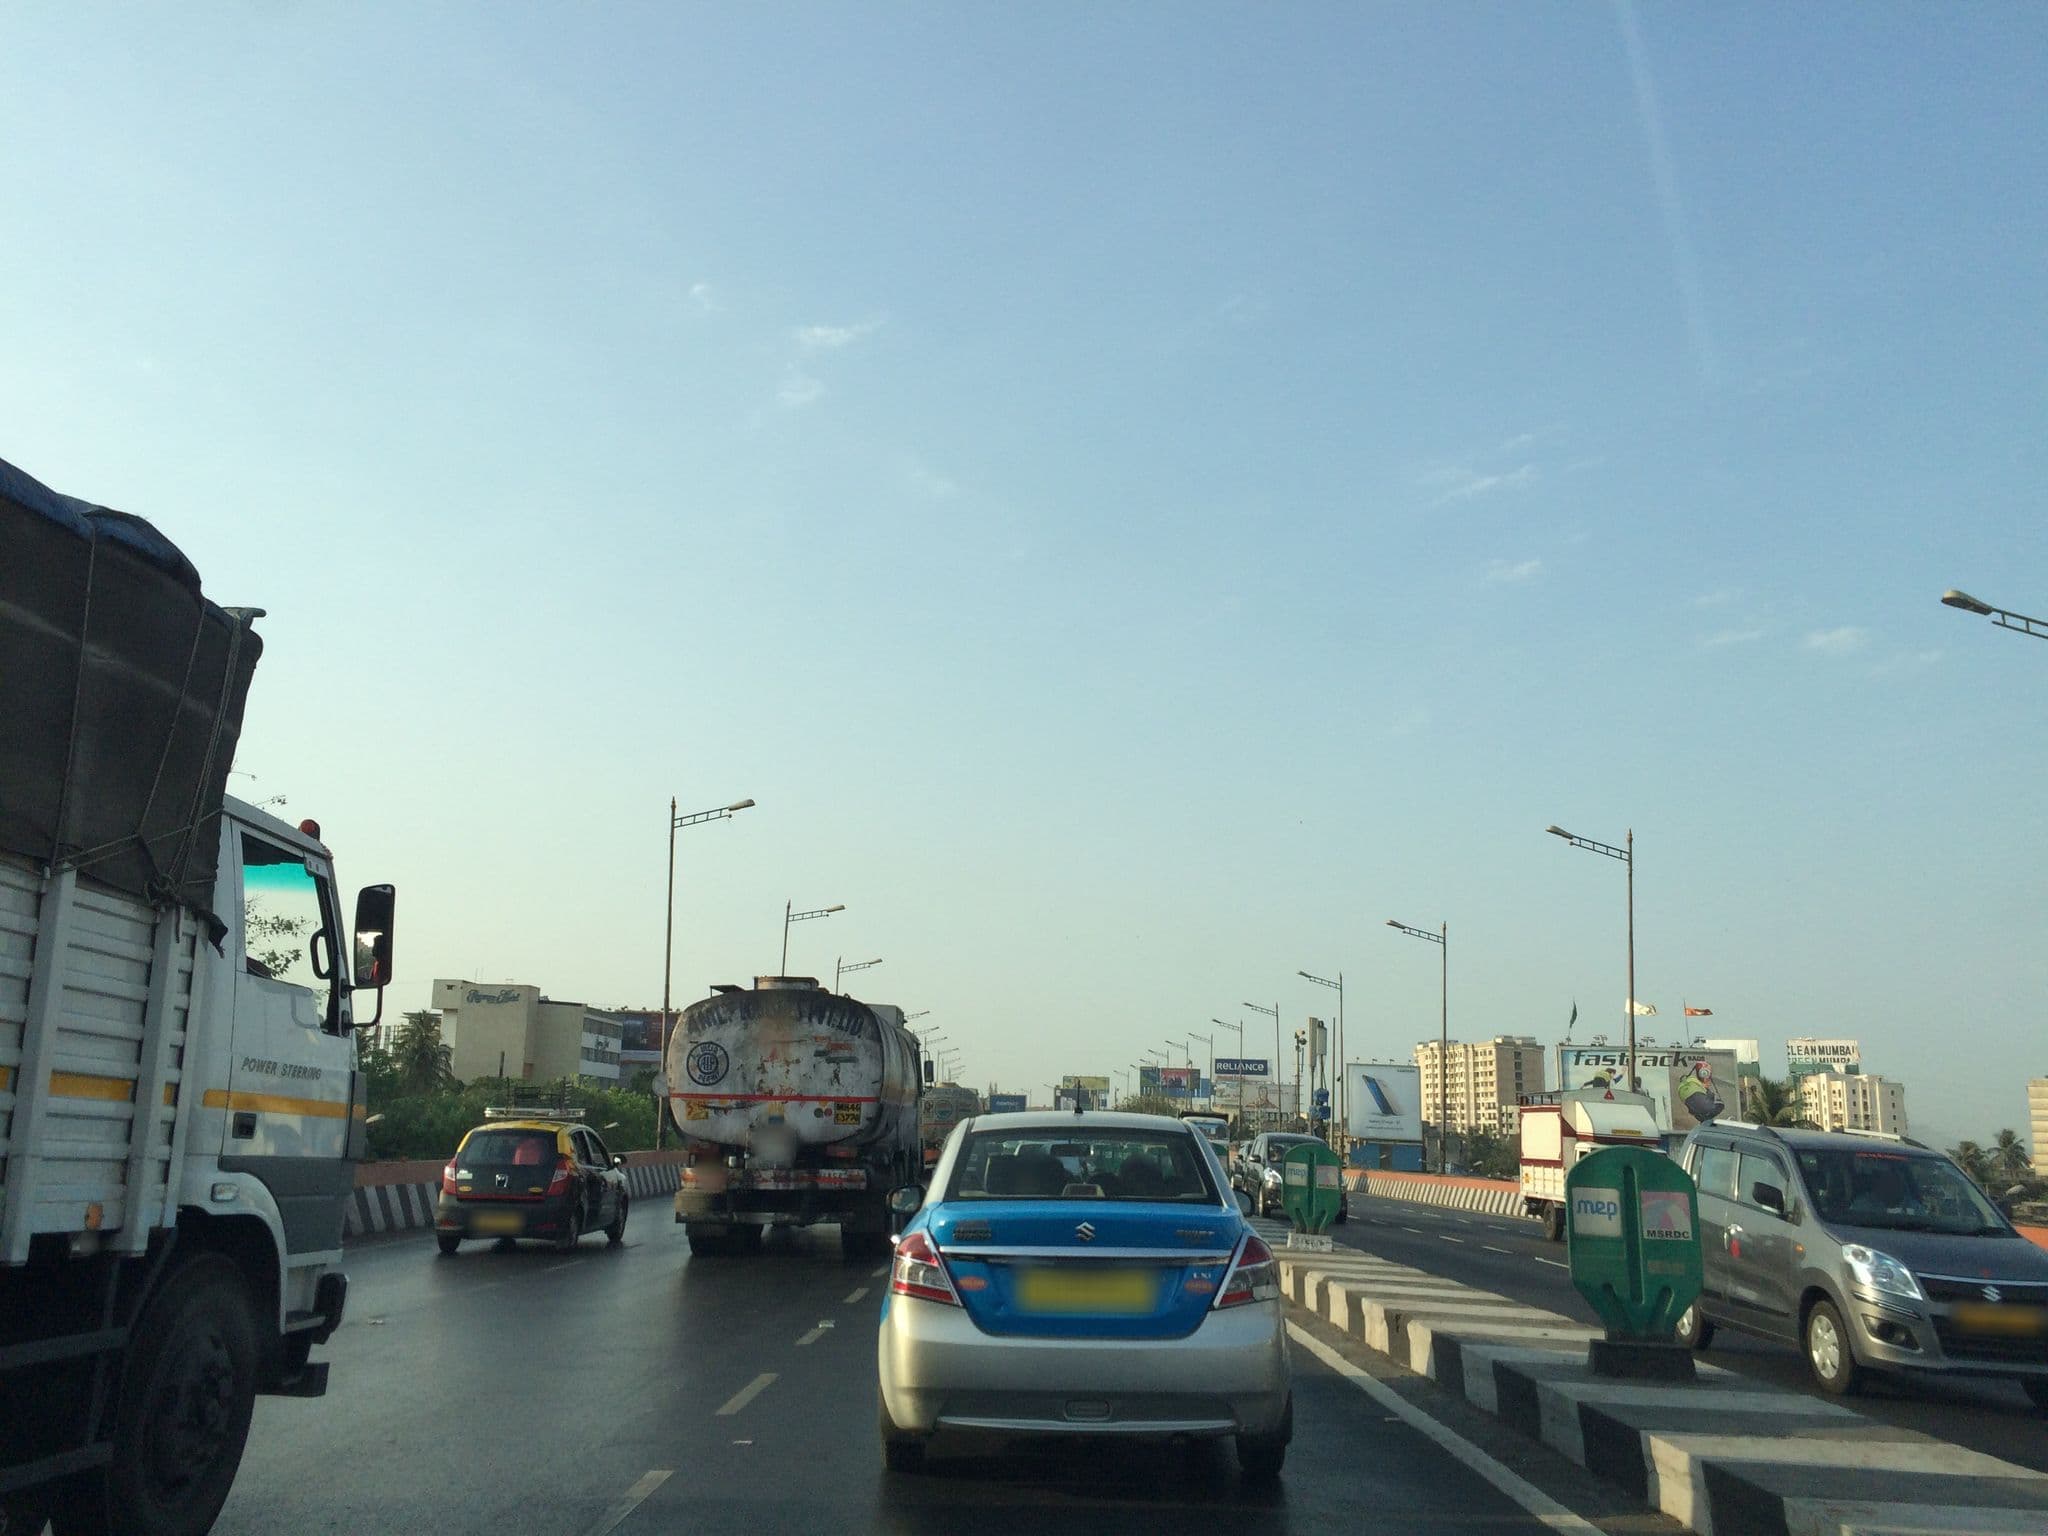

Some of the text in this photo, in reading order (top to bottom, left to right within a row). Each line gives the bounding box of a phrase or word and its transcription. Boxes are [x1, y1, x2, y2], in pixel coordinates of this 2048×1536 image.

[241, 1056, 322, 1081] POWER STEERING
[1577, 1200, 1617, 1221] mep
[1646, 1229, 1690, 1239] MSRDC
